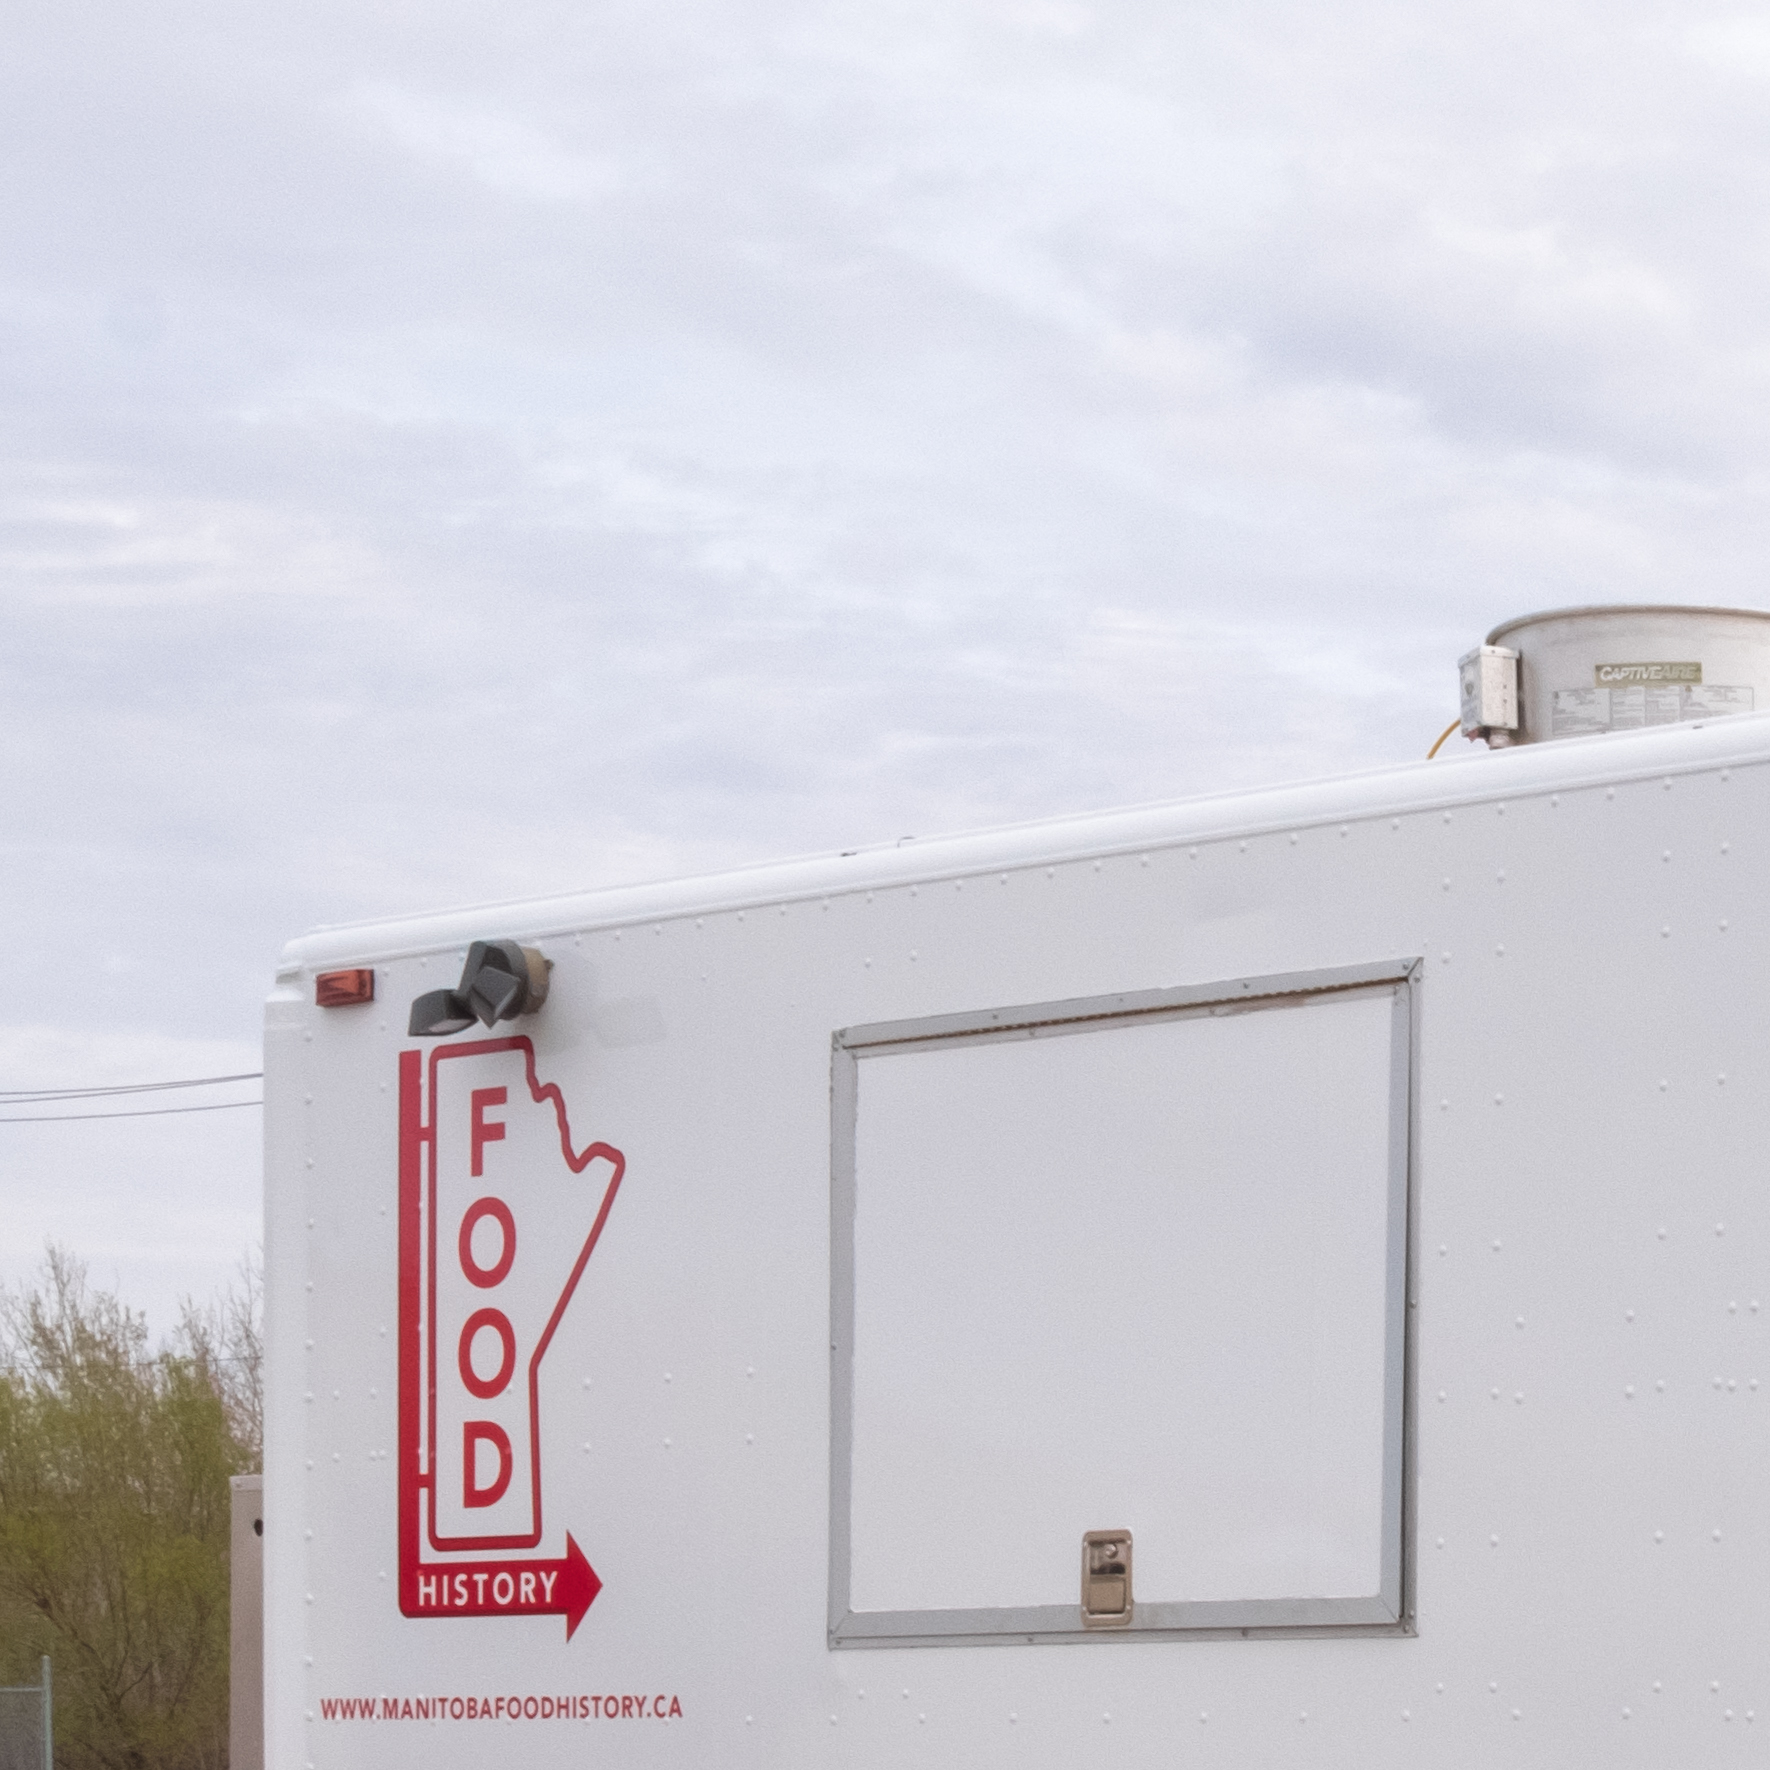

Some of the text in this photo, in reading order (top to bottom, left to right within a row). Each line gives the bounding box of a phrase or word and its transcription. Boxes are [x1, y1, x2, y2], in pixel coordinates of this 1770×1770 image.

[458, 1086, 517, 1509] FOOD
[418, 1571, 558, 1606] HISTORY
[321, 1695, 683, 1721] WWW.MANITOBAFOODHISTORY.CA
